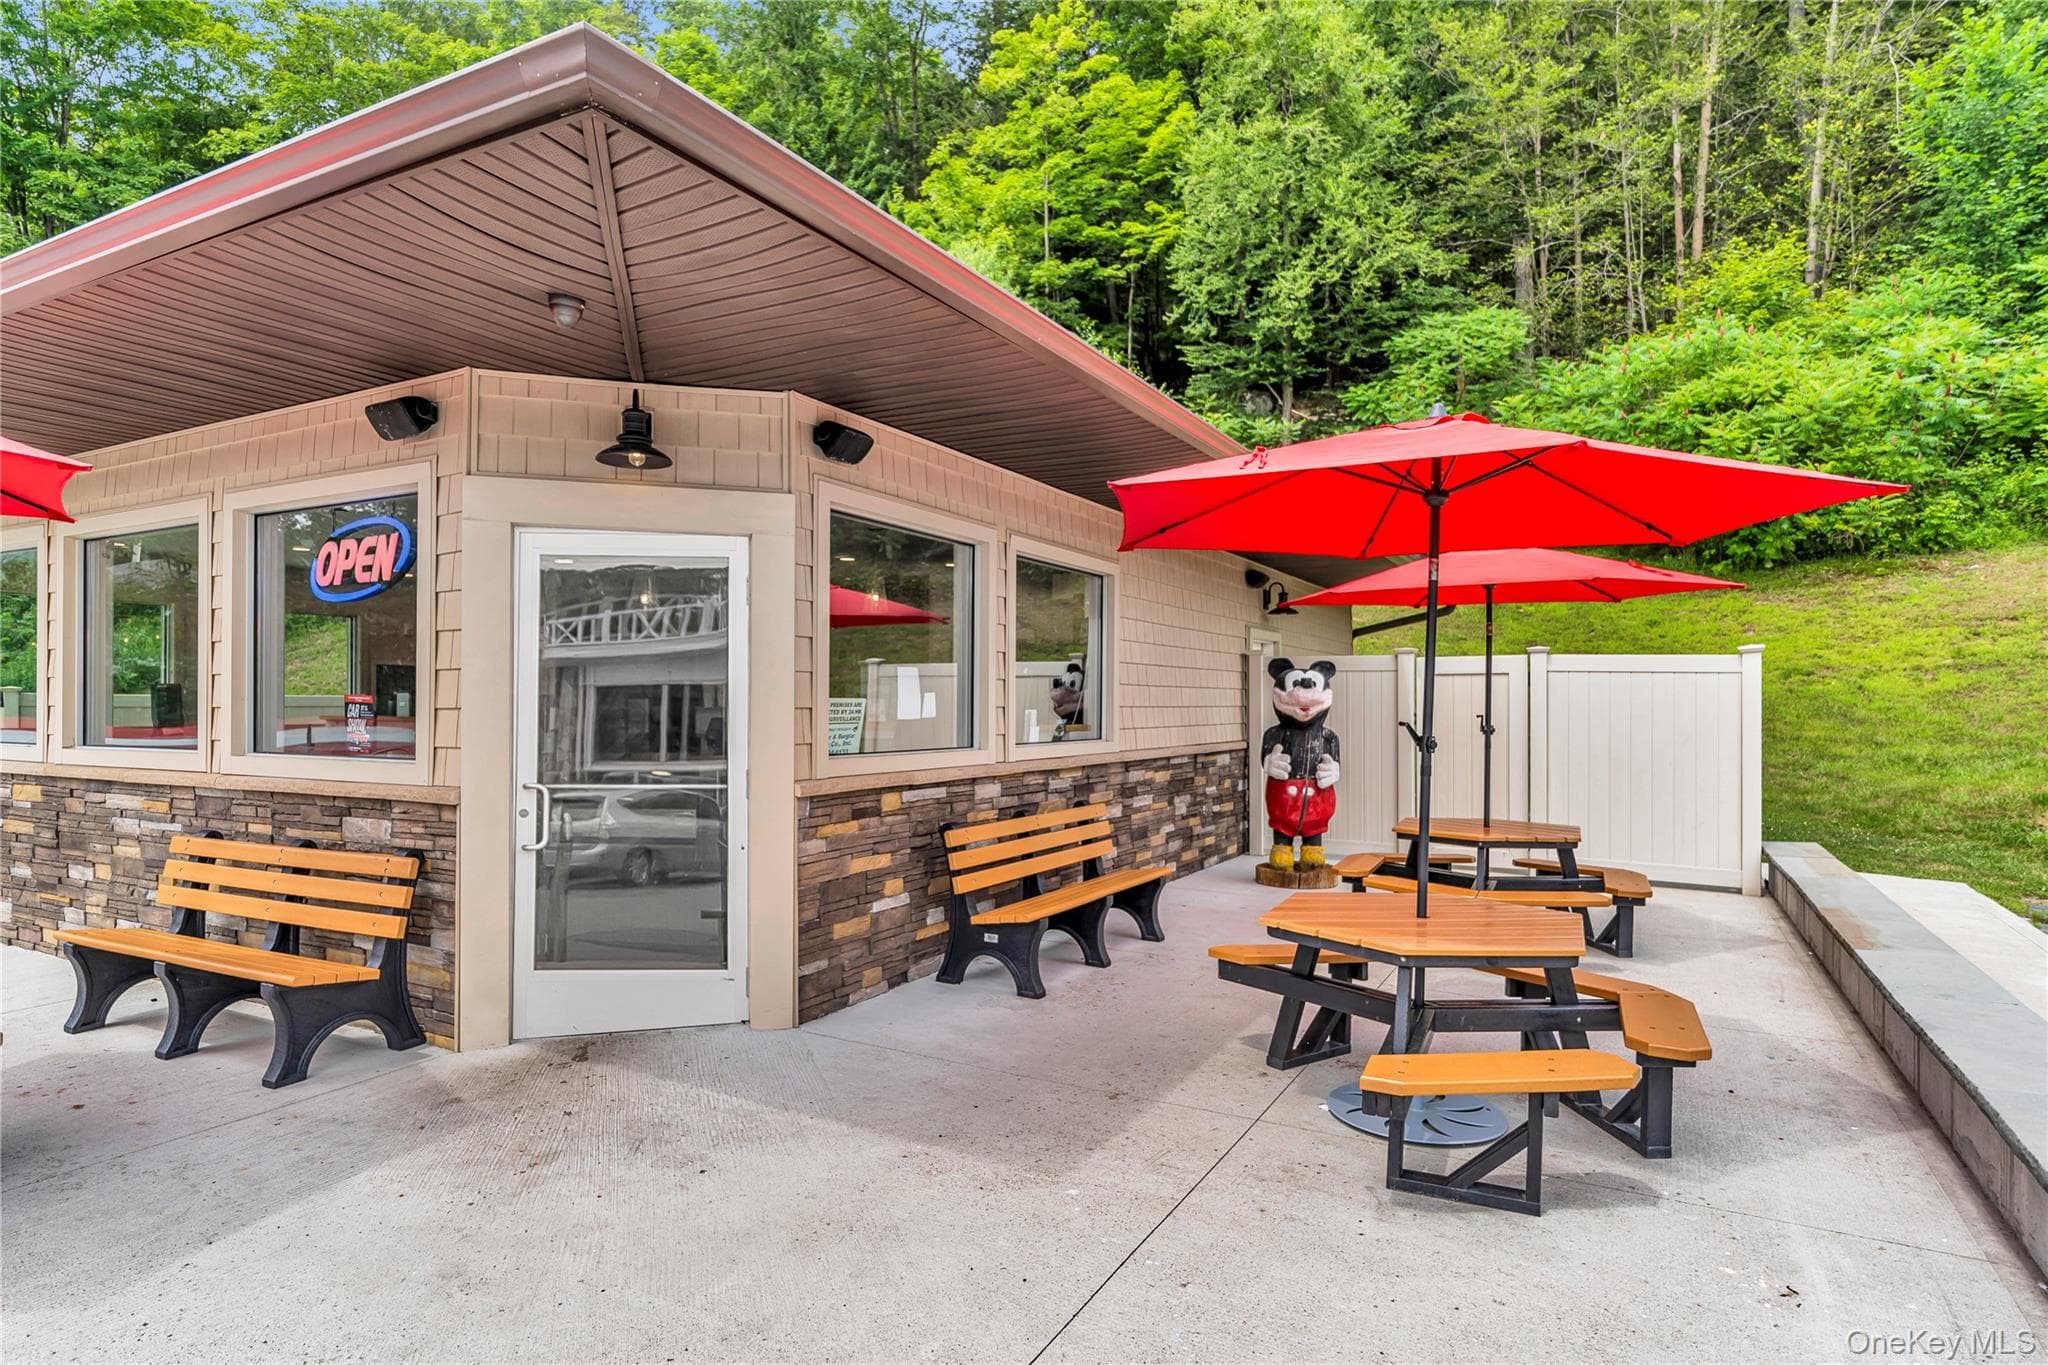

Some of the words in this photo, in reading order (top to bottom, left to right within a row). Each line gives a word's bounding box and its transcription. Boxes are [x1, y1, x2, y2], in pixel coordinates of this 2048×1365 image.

[316, 532, 399, 587] OPEN
[347, 704, 360, 717] CAR
[347, 718, 367, 732] SHOW
